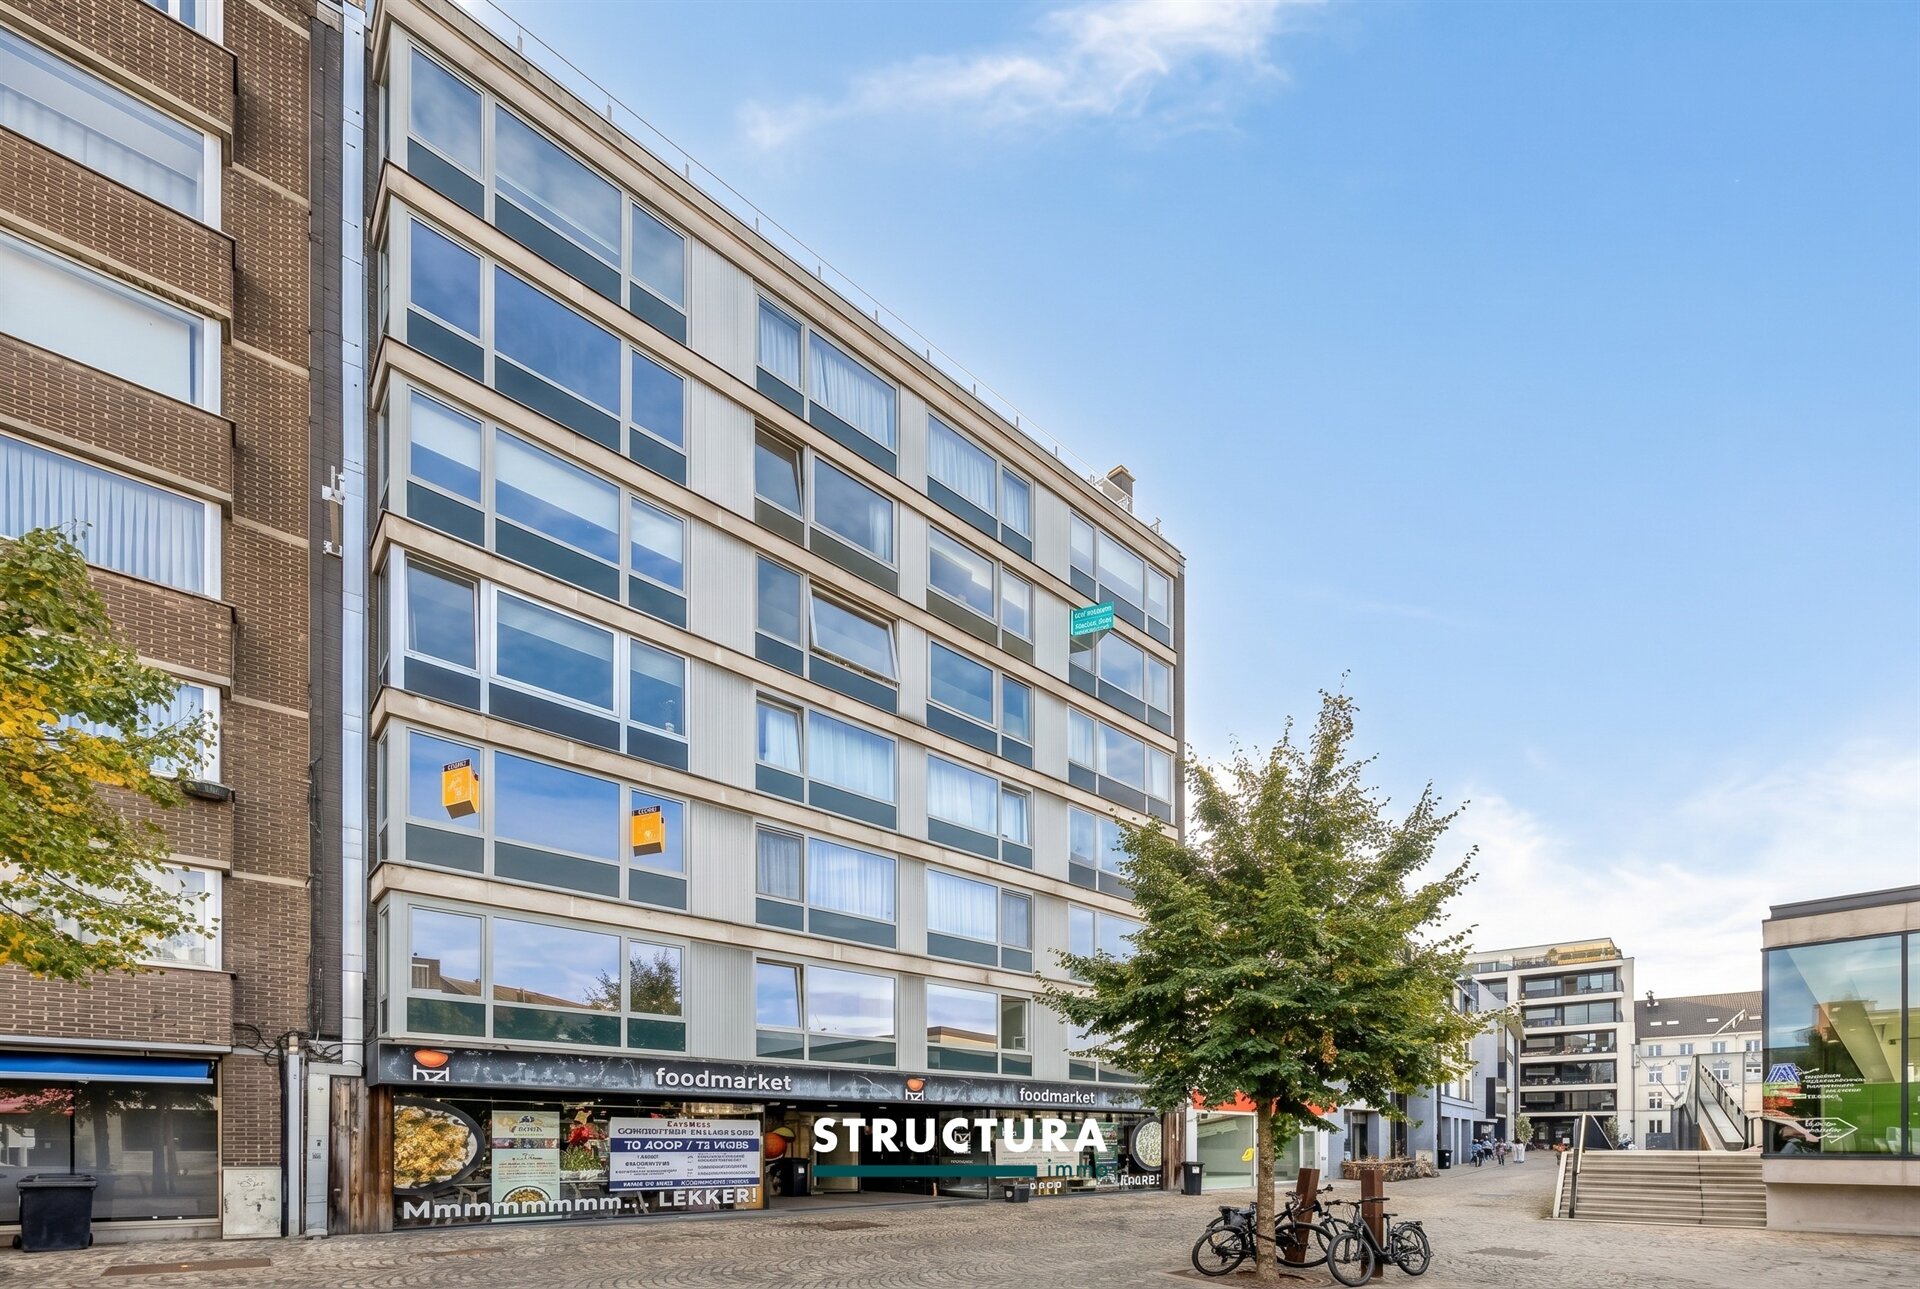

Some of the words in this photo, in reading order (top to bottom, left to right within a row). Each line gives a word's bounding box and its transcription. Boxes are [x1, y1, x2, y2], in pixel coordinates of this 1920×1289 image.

[656, 1067, 792, 1091] foodmarket
[1019, 1087, 1096, 1104] foodmarket
[659, 1187, 757, 1207] LEKKER!
